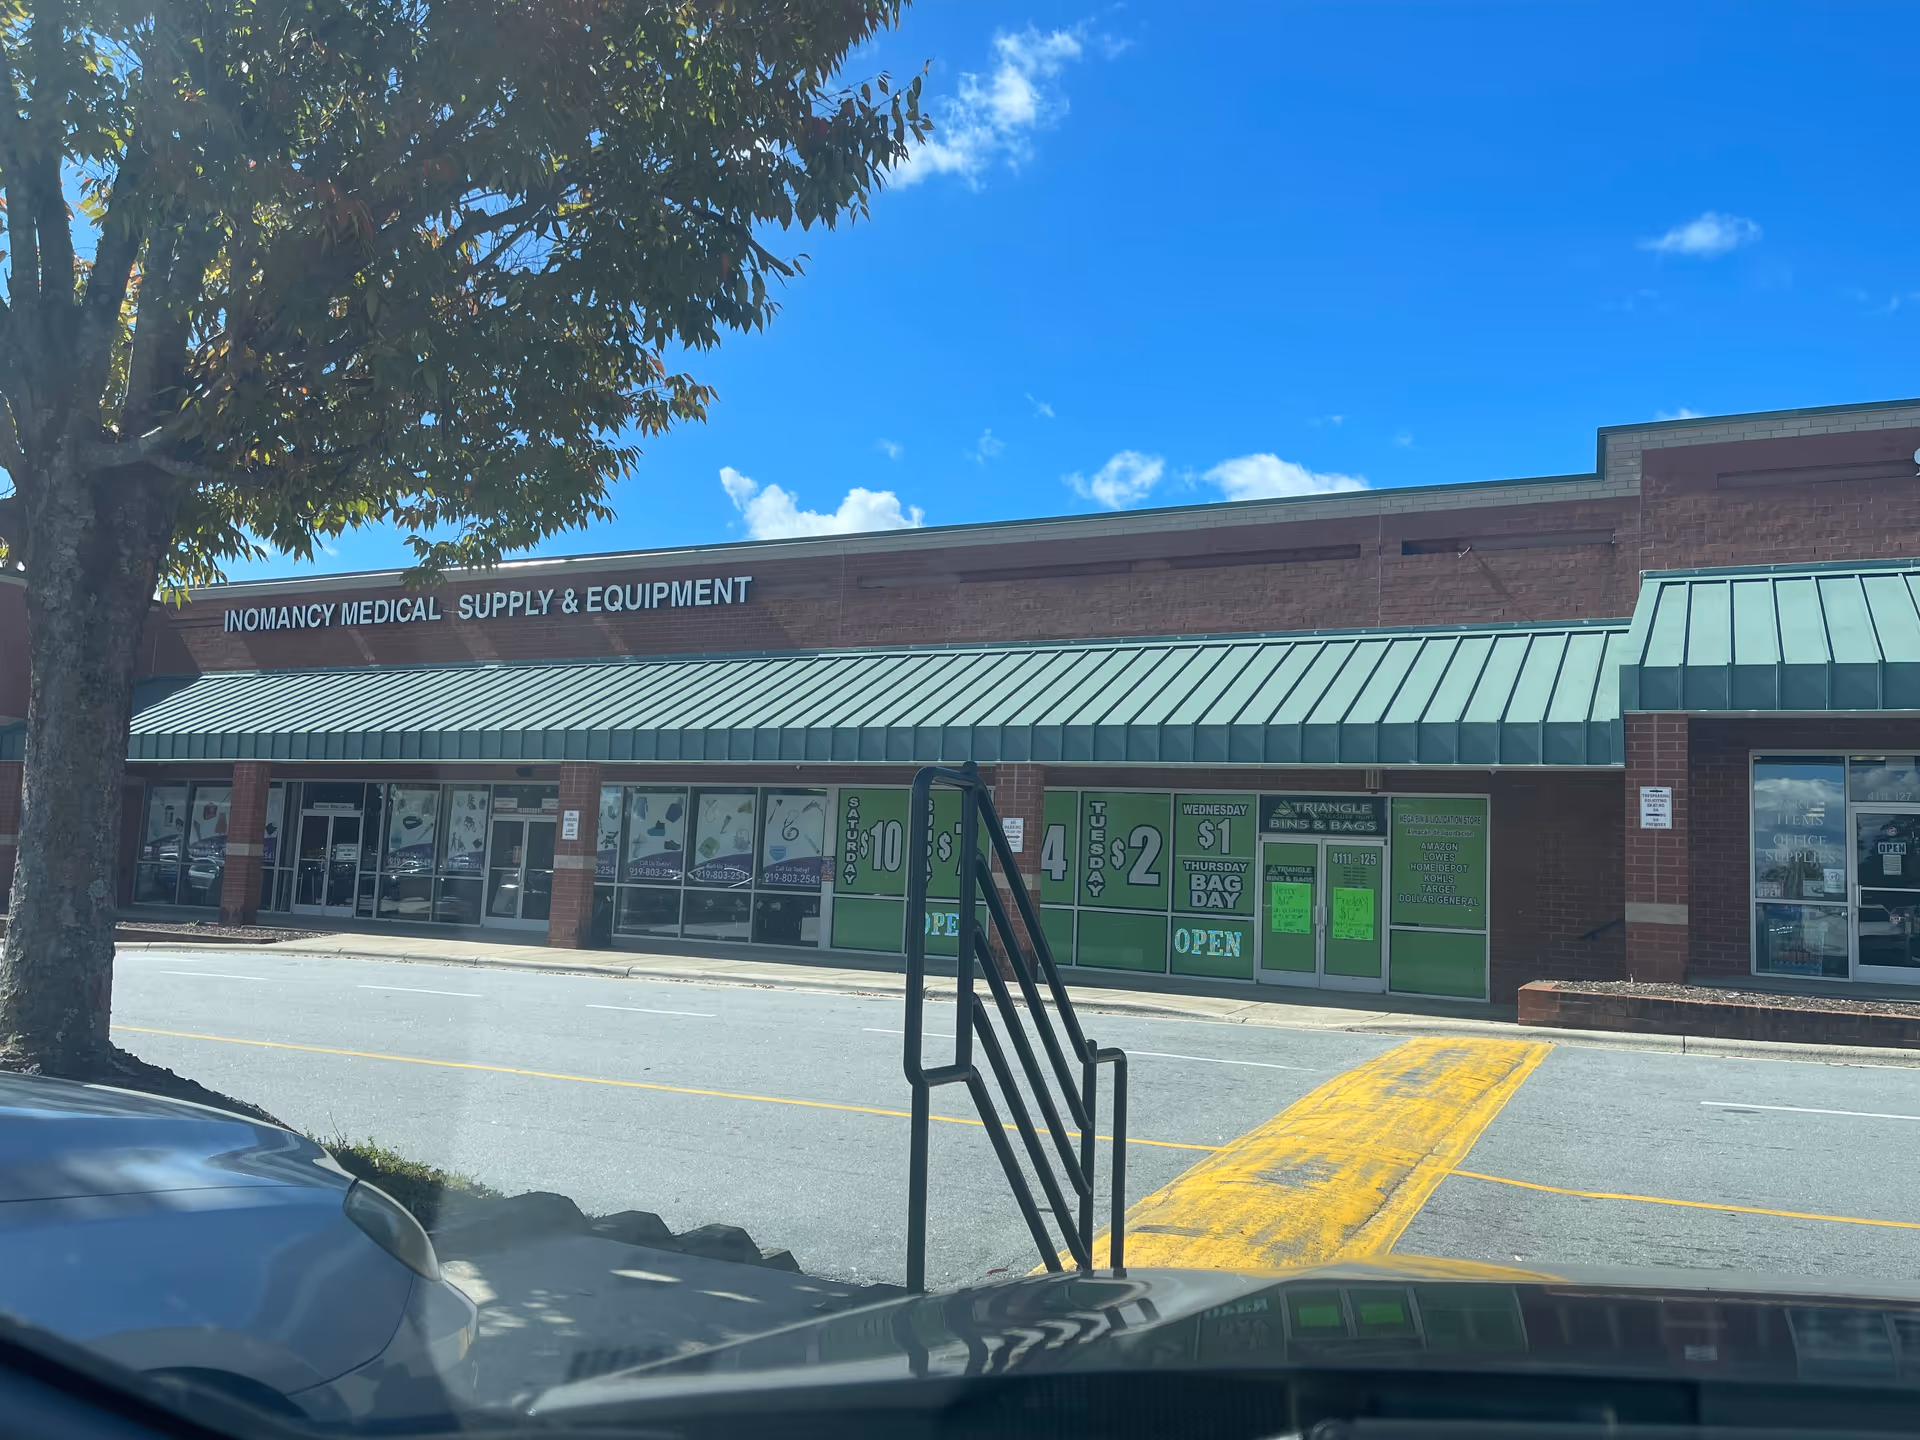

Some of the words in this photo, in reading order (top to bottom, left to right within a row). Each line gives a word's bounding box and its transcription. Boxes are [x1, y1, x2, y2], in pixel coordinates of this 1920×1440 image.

[224, 603, 336, 632] INOMANCY
[341, 596, 441, 626] MEDICAL
[458, 588, 554, 619] SUPPLY
[561, 588, 578, 614] &
[587, 576, 753, 612] EQUIPMENT
[1182, 804, 1248, 816] WEDNESDAY
[1291, 802, 1373, 815] TRIANGLE
[1269, 819, 1310, 829] BINS
[1312, 820, 1326, 830] &
[1329, 820, 1377, 831] BAGS
[1463, 816, 1481, 825] STORE
[1777, 813, 1823, 826] ITEMS
[843, 797, 860, 885] SATURDAY
[1197, 818, 1231, 855] $1
[1773, 834, 1827, 847] OFFICE
[860, 820, 903, 872] $10
[1086, 801, 1106, 897] TUESDAY
[1420, 842, 1458, 851] AMAZON
[1880, 843, 1905, 853] OPEN
[1110, 824, 1163, 886] $2
[1332, 852, 1352, 865] 4111
[1360, 853, 1377, 866] 125
[1423, 852, 1455, 861] LOWES
[1765, 850, 1836, 863] SUPPLIES
[1183, 860, 1248, 873] THURSDAY
[1277, 866, 1312, 874] TRIANGLE
[1409, 862, 1435, 871] HOME
[1438, 864, 1469, 873] DEPOT
[764, 873, 820, 884] 919-803-2541
[1190, 874, 1242, 892] BAG
[1424, 874, 1454, 883] KOHLS
[1421, 884, 1456, 894] TARGET
[1190, 891, 1240, 909] DAY
[1398, 894, 1434, 904] DOLLAR
[1436, 895, 1480, 906] GENERAL
[1174, 928, 1242, 957] OPEN
